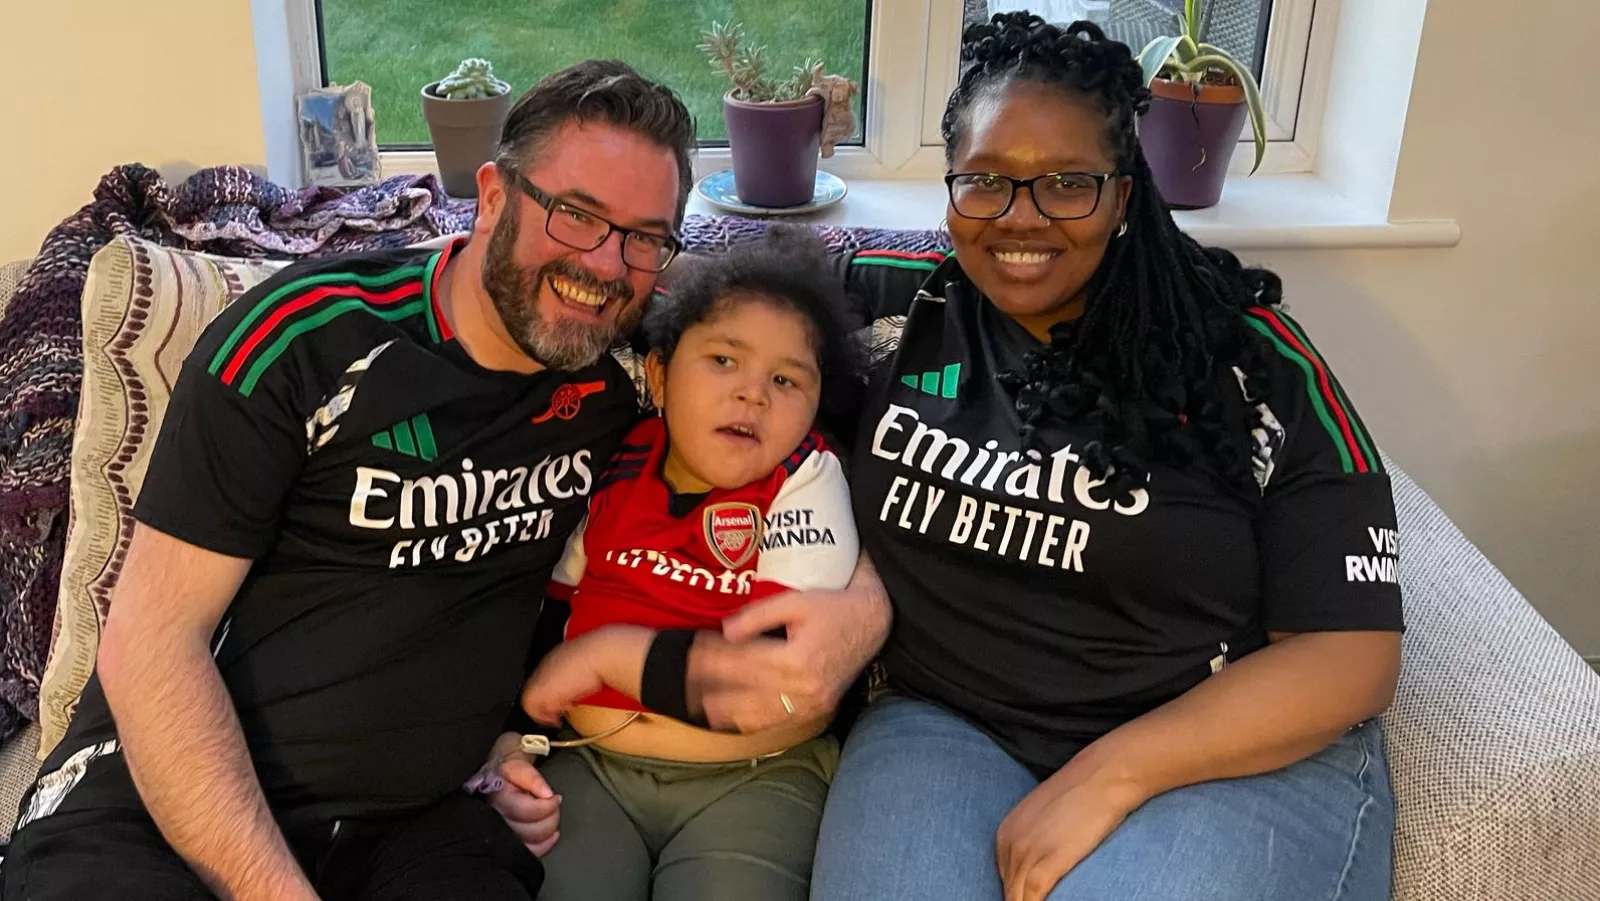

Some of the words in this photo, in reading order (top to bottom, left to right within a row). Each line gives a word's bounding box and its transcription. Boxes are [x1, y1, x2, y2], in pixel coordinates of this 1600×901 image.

[349, 449, 593, 530] Emirates
[715, 514, 752, 527] Arsenal
[764, 509, 814, 531] VISIT
[879, 476, 946, 535] FLY
[949, 494, 1091, 573] BETTER
[758, 527, 836, 554] WANDA
